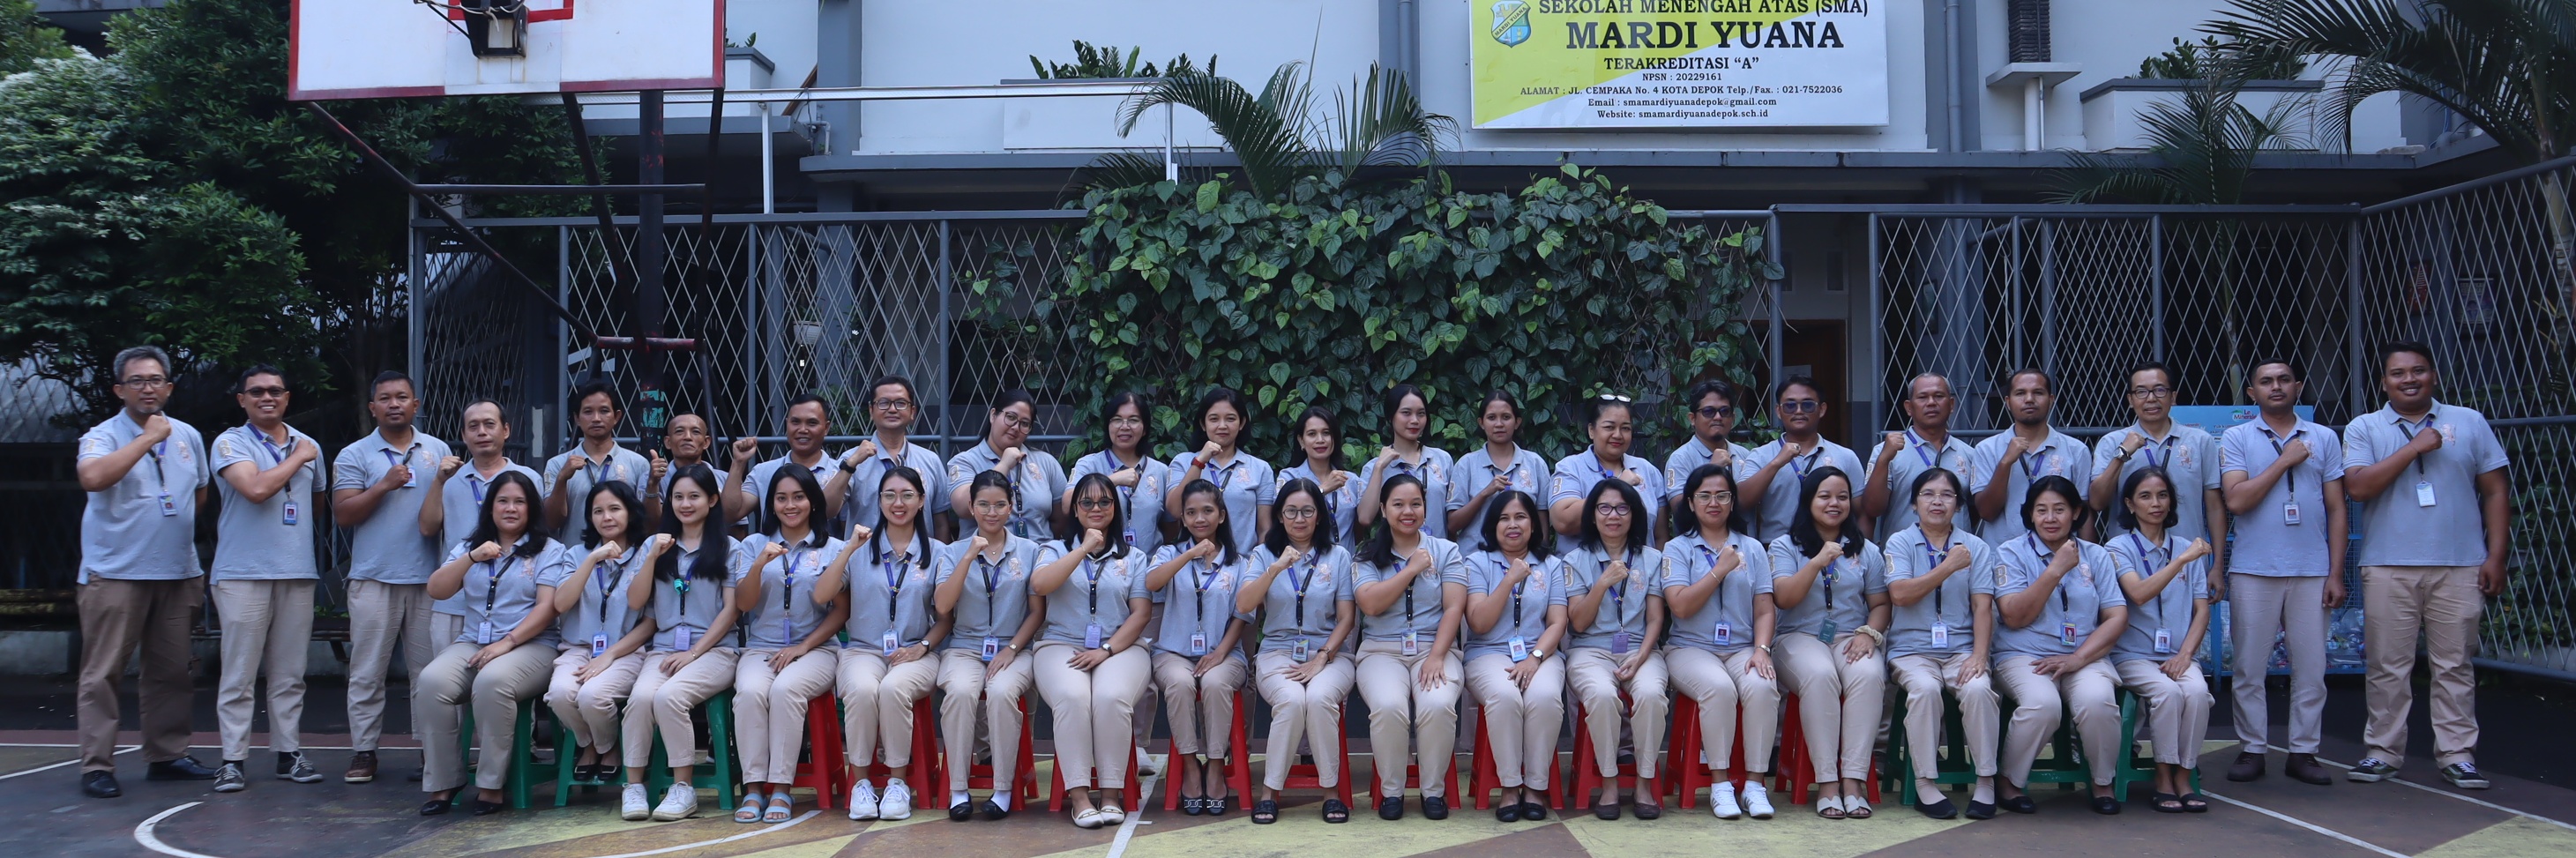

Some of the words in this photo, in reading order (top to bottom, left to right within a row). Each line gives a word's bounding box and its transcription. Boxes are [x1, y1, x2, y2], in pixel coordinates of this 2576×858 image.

[1539, 0, 1633, 13] SEKOLAH
[1640, 0, 1751, 13] MENENGAH
[1758, 0, 1809, 13] ATAS
[1815, 0, 1869, 18] (SMA)
[1494, 21, 1511, 37] MARDI
[1510, 7, 1527, 23] YUANA
[1565, 21, 1699, 49] MARDI
[1711, 21, 1845, 48] YUANA
[1603, 56, 1729, 70] TERAKREDITASI
[1676, 72, 1722, 81] 20229161
[1520, 86, 1560, 95] ALAMAT
[1568, 86, 1583, 95] JL.
[1691, 86, 1724, 94] DEPOK
[1623, 97, 1777, 108] smamardiyuanadepok@gmail.com
[1597, 109, 1636, 118] Website:
[1639, 108, 1769, 119] smamardiyuanadepok.sch.id
